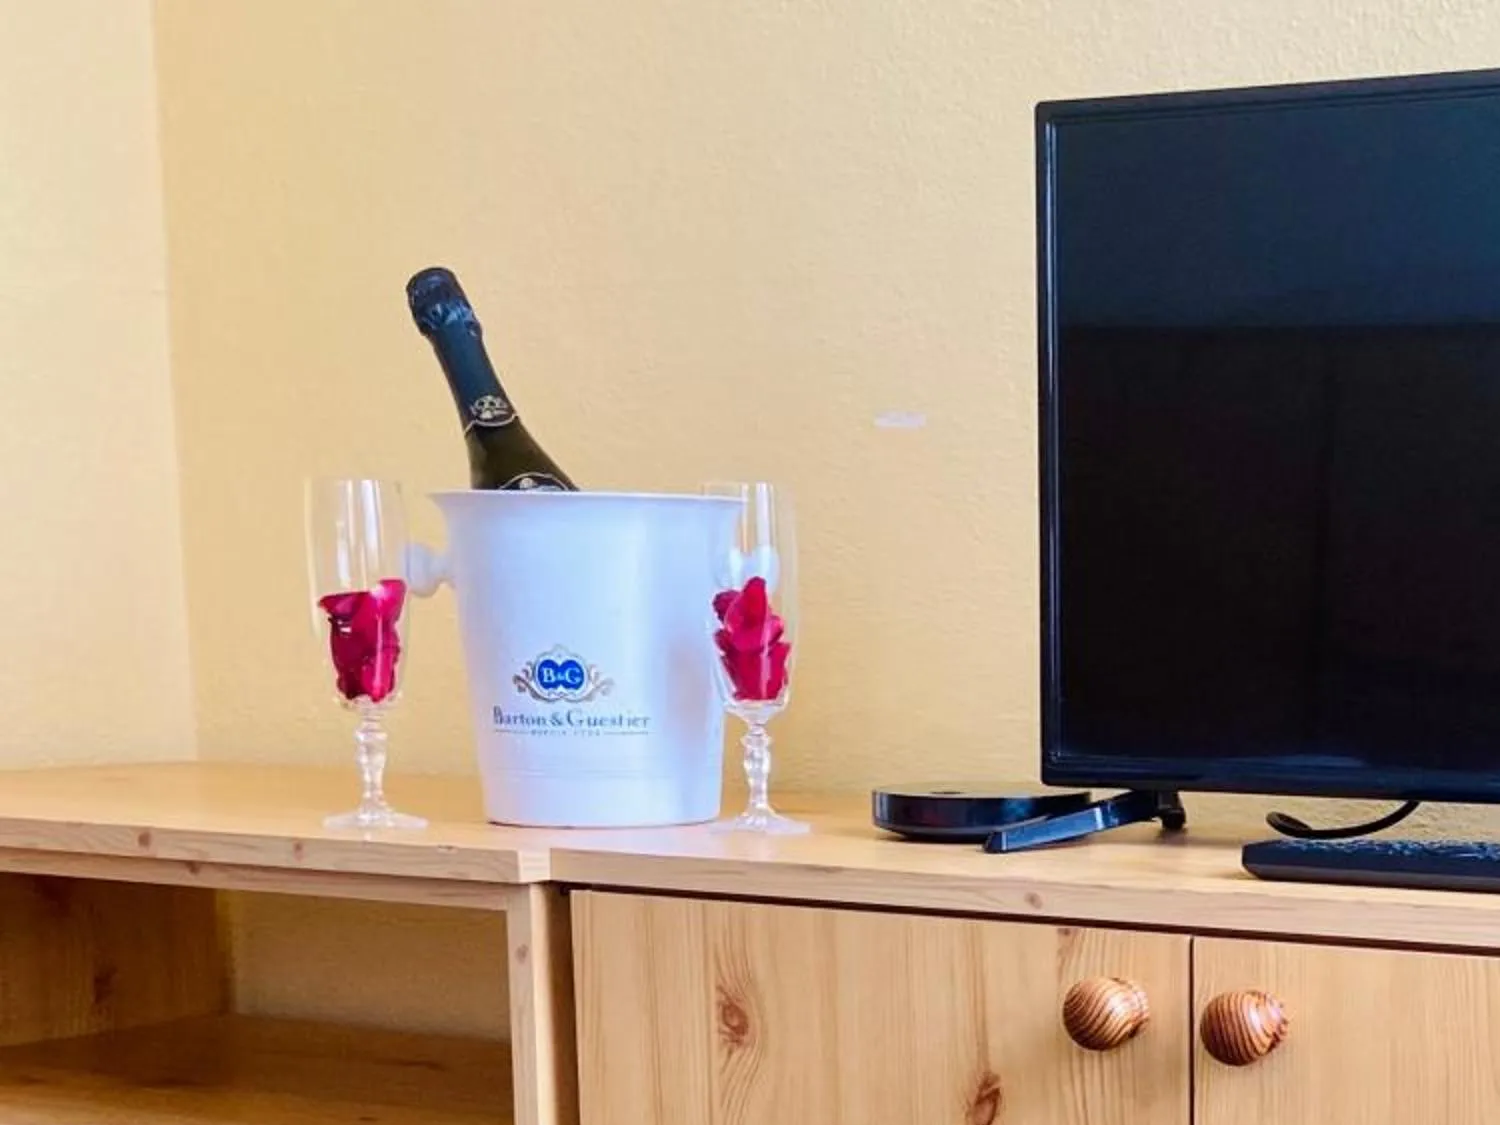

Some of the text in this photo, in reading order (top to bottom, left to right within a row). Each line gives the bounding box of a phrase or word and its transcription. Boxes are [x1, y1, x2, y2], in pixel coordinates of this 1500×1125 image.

[493, 705, 651, 728] Barton & Guestier
